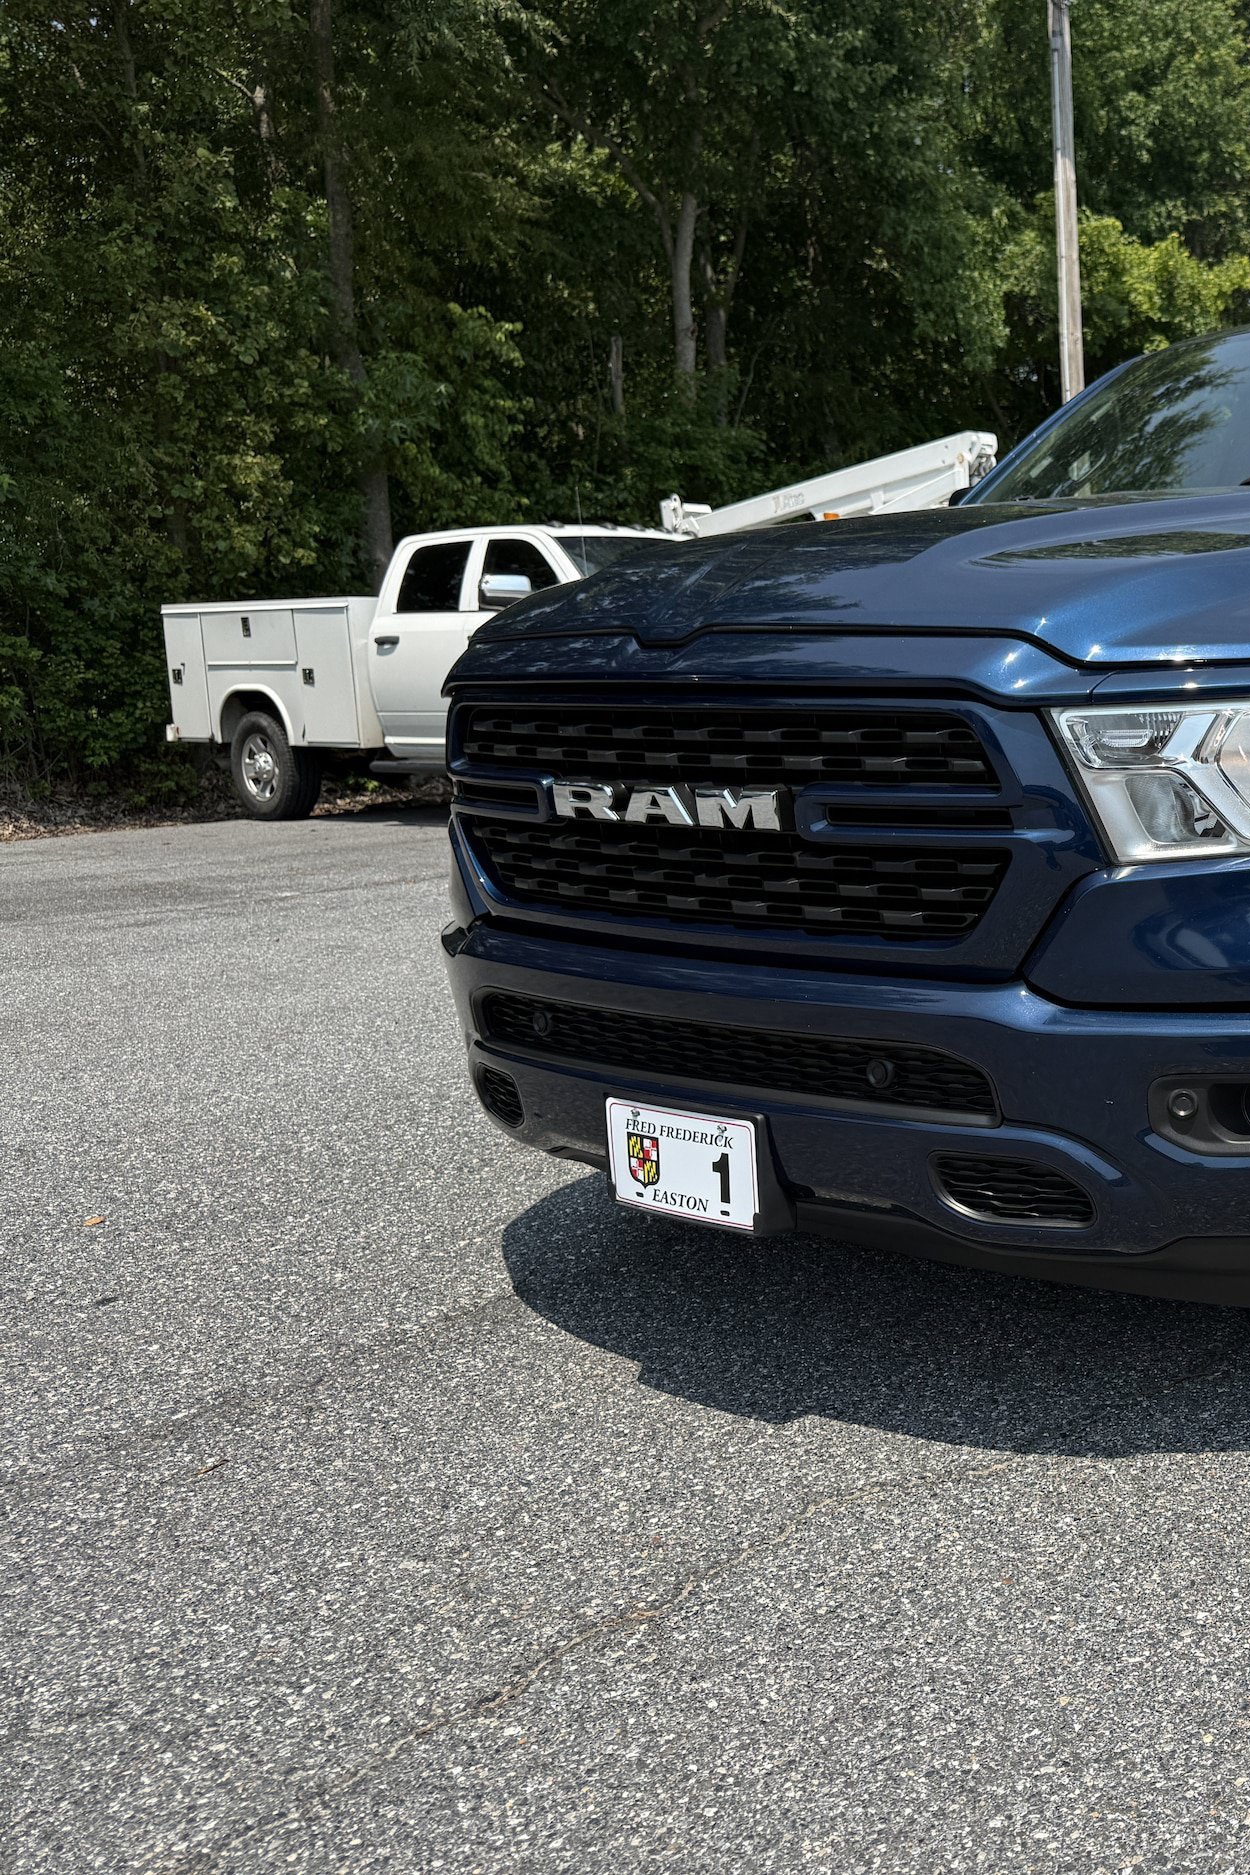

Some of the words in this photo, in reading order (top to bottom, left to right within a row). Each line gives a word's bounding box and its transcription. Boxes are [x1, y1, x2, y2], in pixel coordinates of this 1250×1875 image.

[552, 780, 781, 831] RAM
[625, 1118, 657, 1135] FRED
[659, 1125, 734, 1149] FREDERICK
[711, 1152, 732, 1205] 1
[652, 1188, 709, 1213] EASTON
